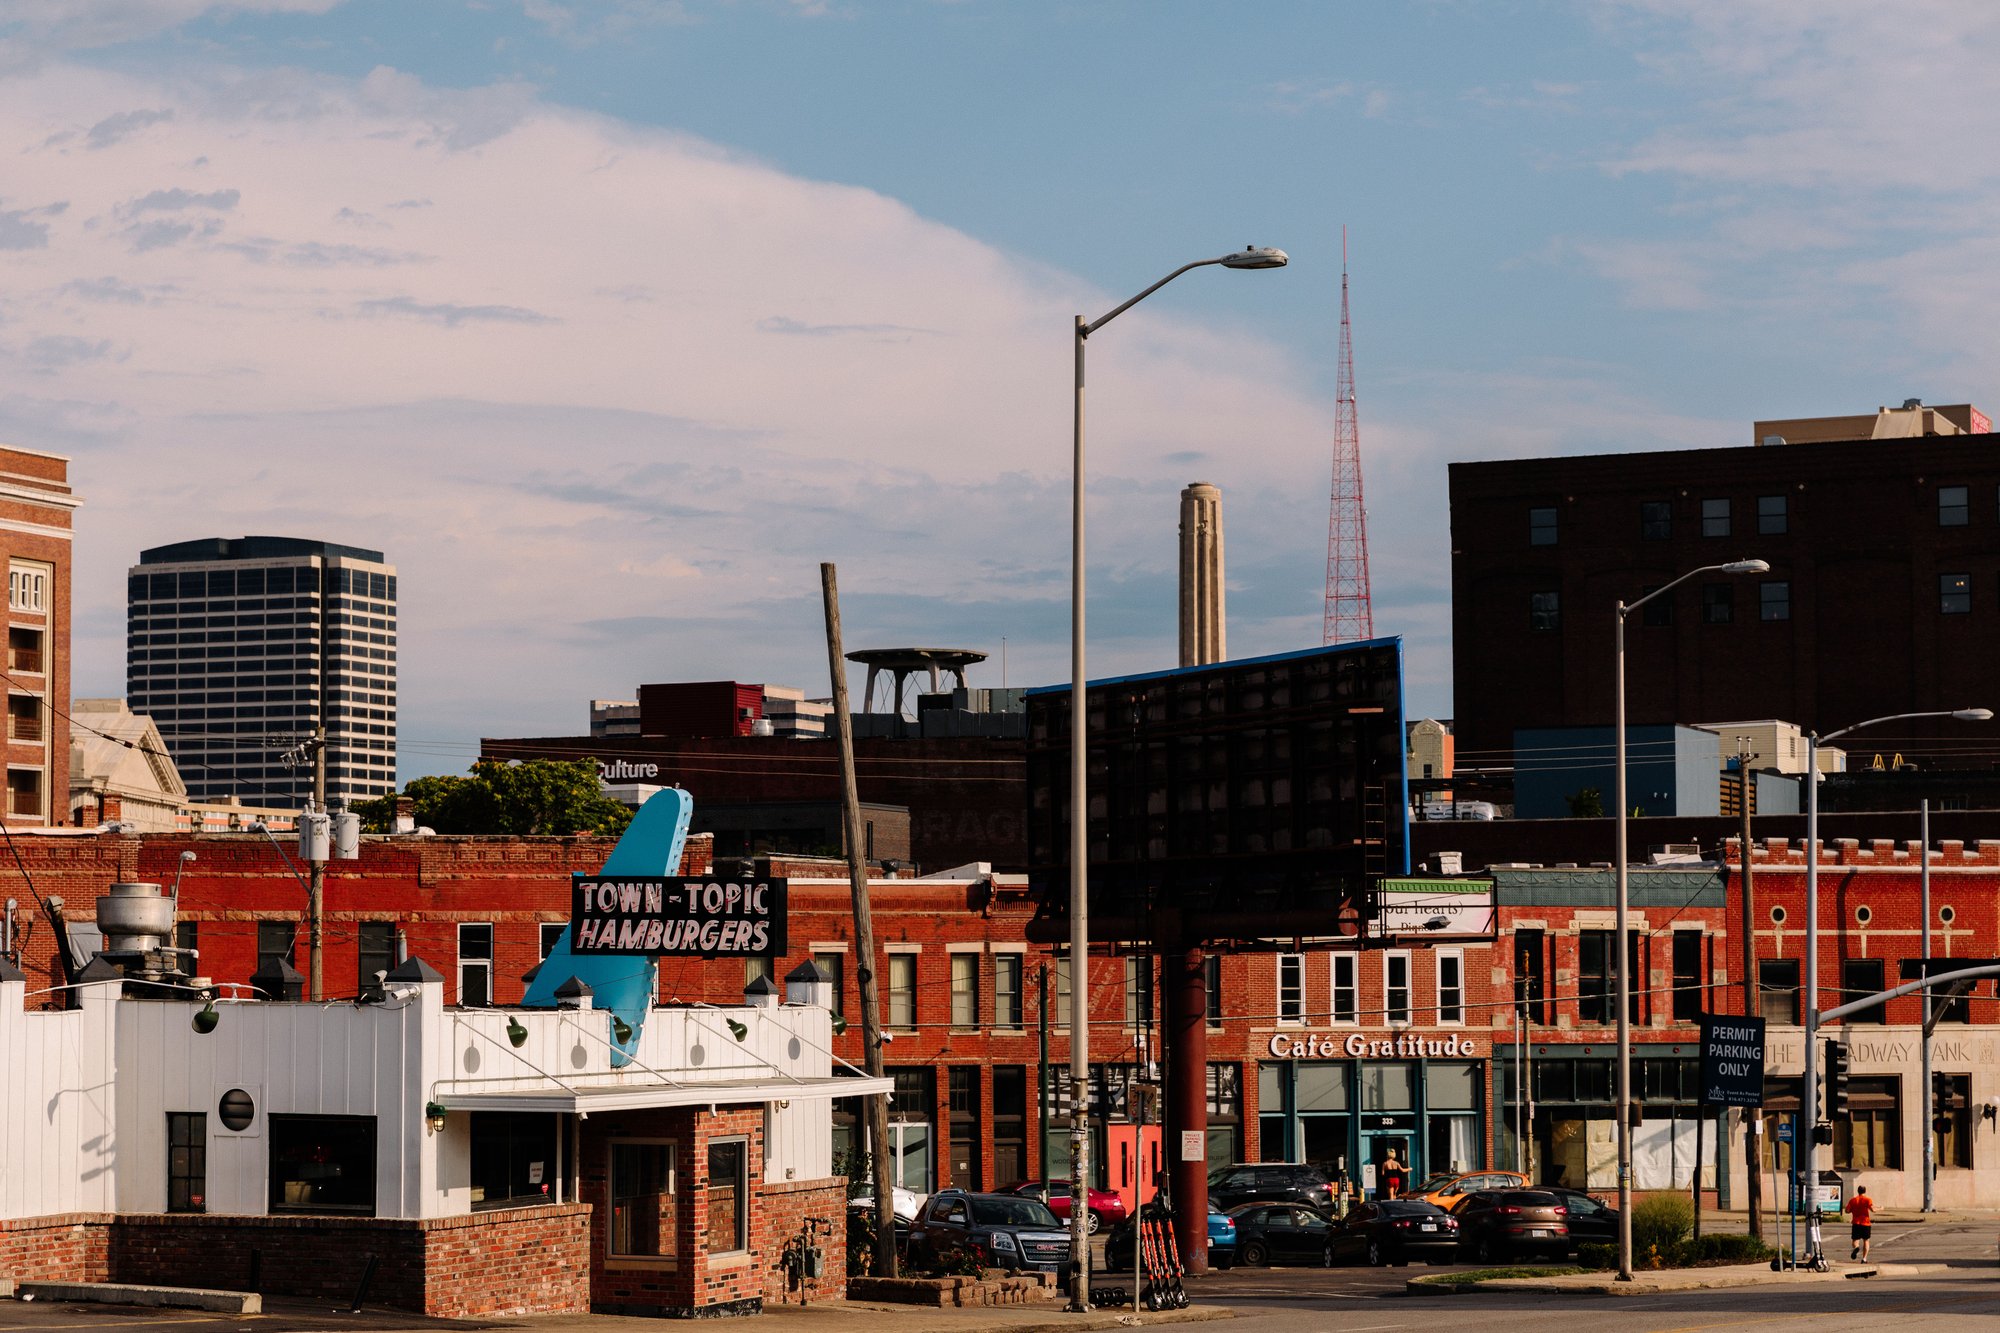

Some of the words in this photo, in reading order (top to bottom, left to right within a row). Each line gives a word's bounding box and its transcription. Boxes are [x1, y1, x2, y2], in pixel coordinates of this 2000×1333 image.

[910, 808, 1027, 843] RAG
[576, 918, 770, 951] HAMBURGERS
[1712, 1026, 1756, 1041] PERMIT
[1270, 1034, 1334, 1057] Café
[1346, 1034, 1475, 1057] Gratitude
[1709, 1043, 1761, 1060] PARKING
[1815, 1042, 1914, 1063] RADWAY
[1718, 1062, 1751, 1077] ONLY
